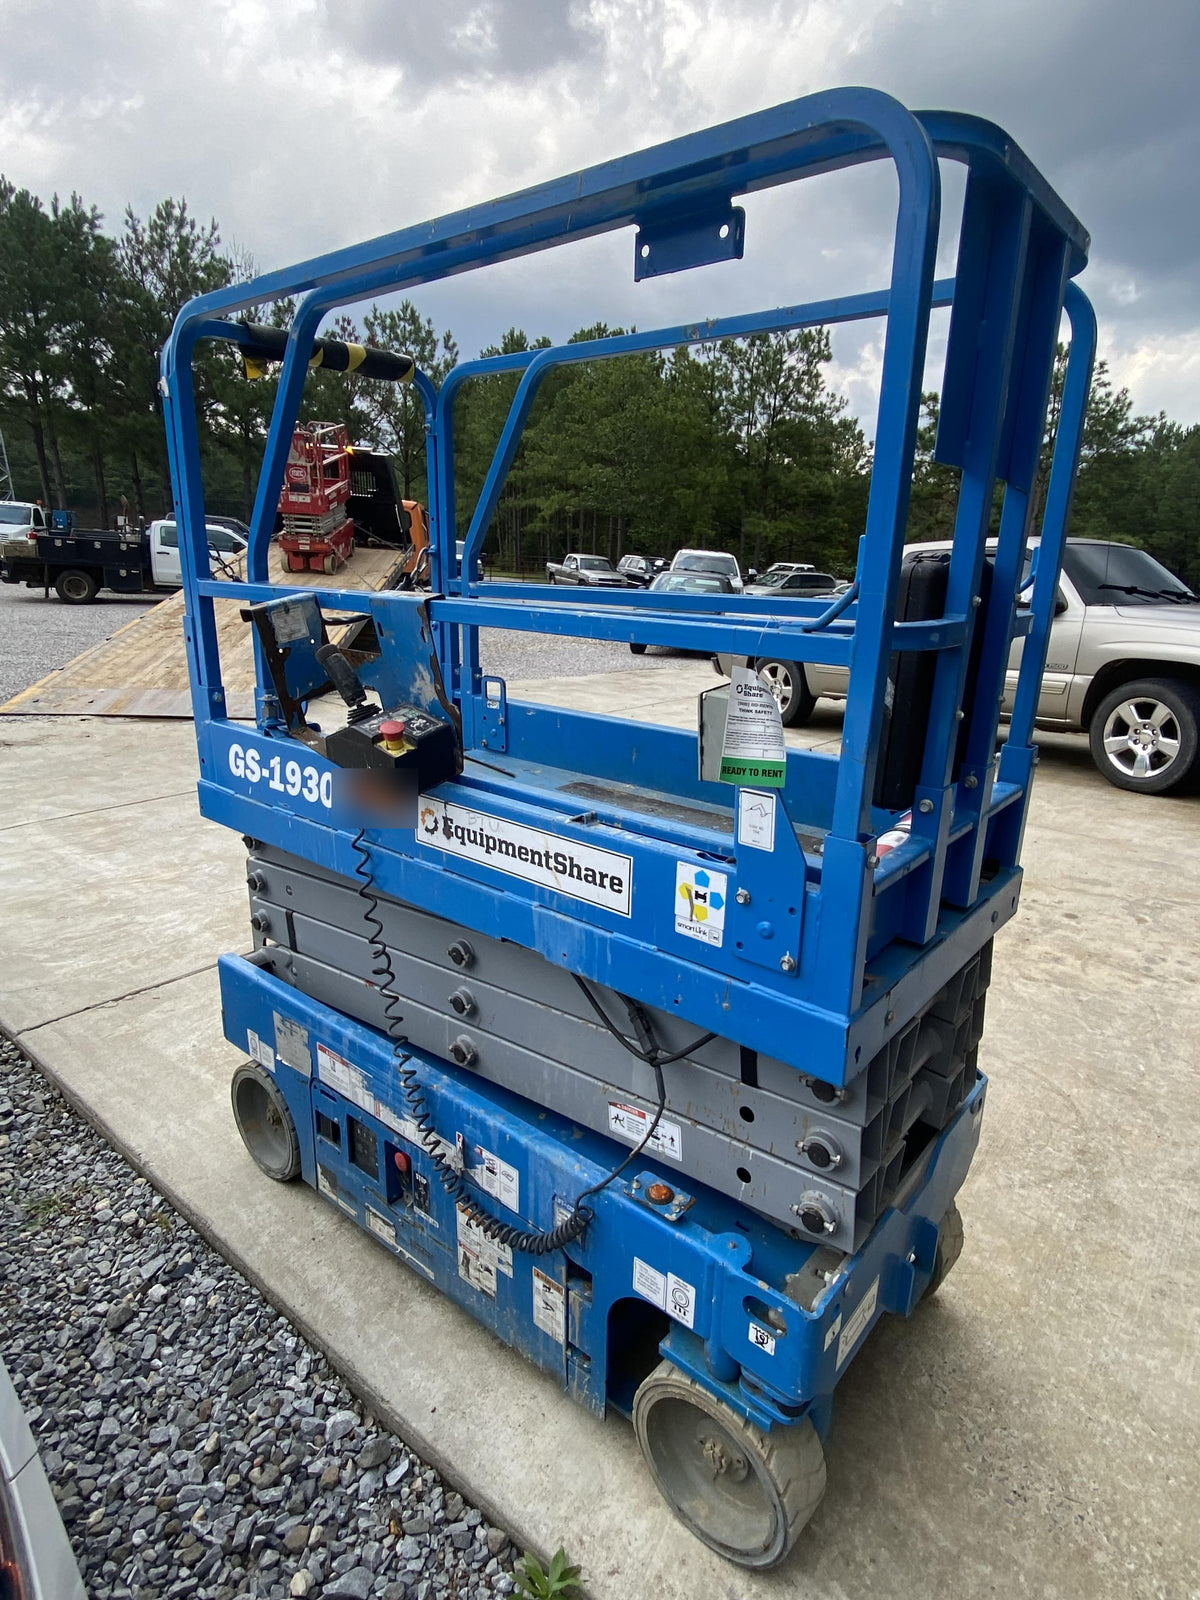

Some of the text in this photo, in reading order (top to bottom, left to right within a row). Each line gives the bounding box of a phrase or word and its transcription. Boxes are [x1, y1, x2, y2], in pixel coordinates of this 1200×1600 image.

[229, 743, 332, 808] GS-1930
[721, 765, 783, 778] READY TO RENT
[441, 815, 623, 895] EquipmentShare
